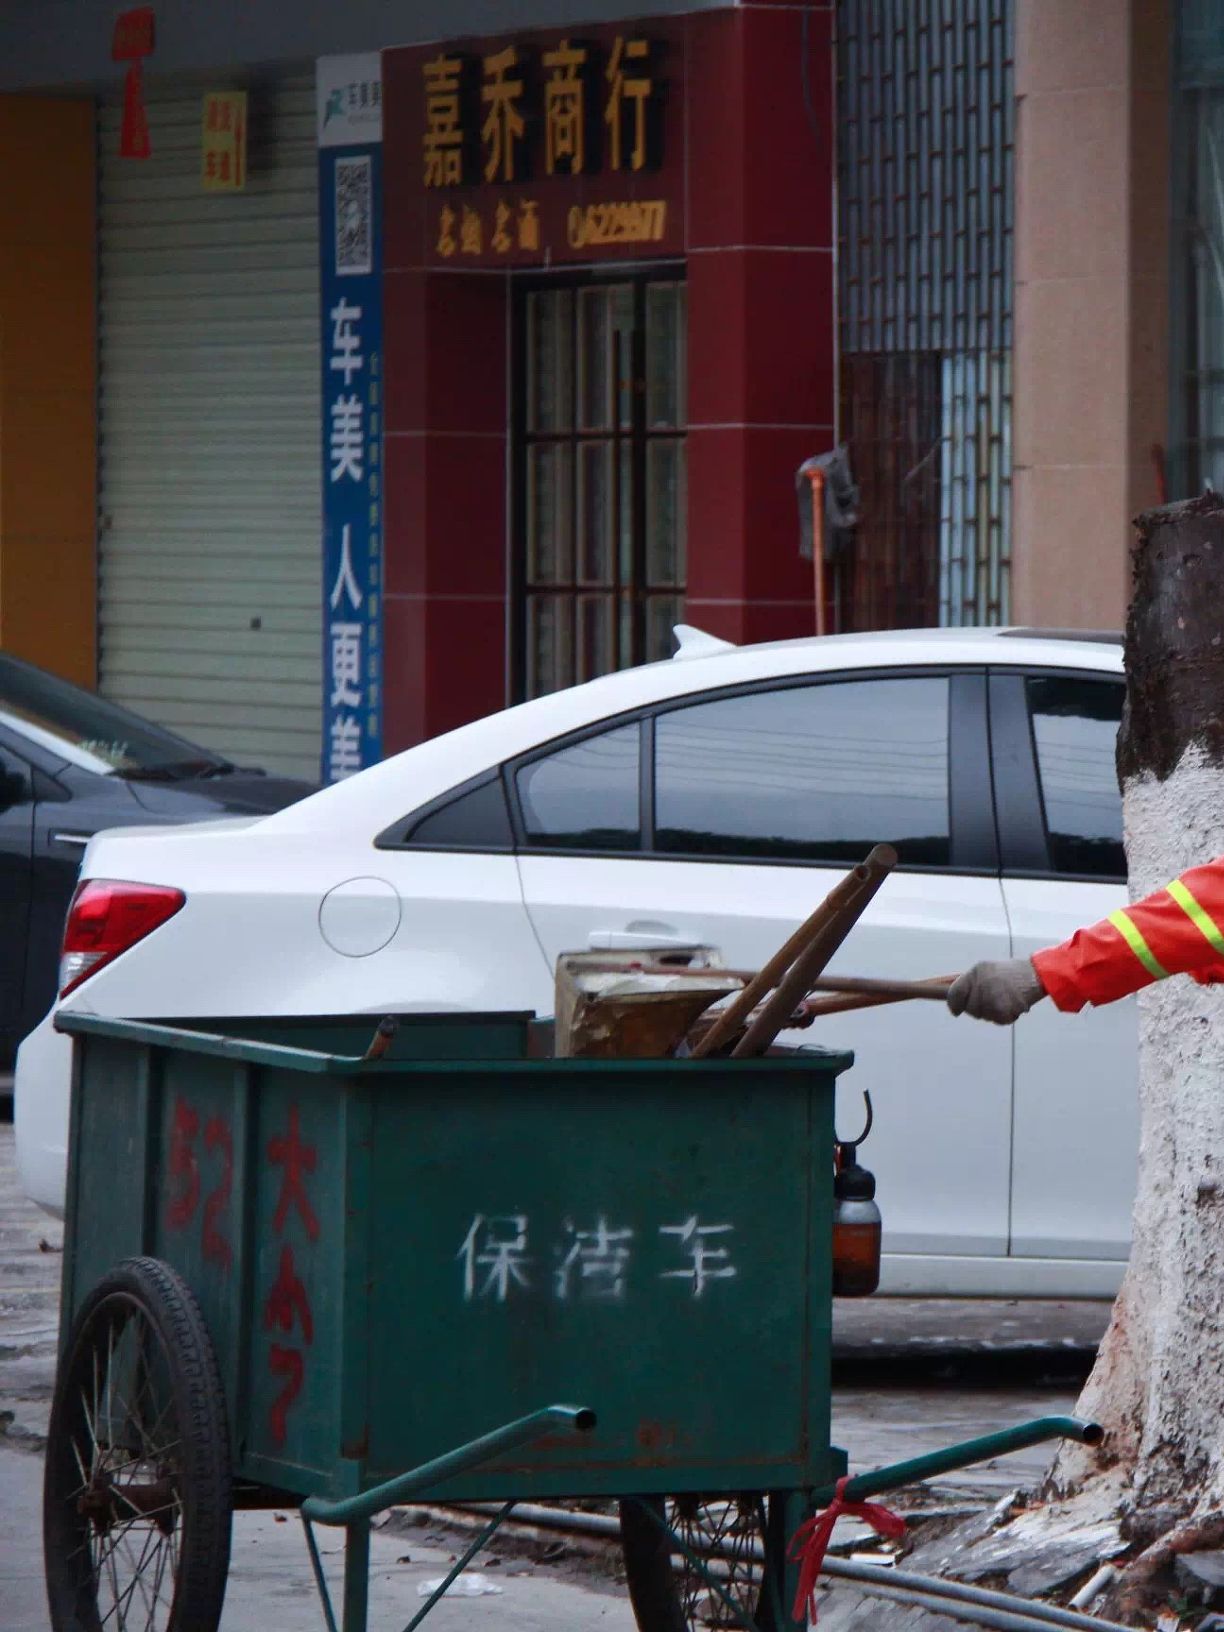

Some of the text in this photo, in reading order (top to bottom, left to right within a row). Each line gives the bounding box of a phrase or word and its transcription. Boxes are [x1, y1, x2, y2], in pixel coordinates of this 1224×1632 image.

[423, 36, 652, 187] 嘉乔商行
[456, 1212, 737, 1300] 保洁车
